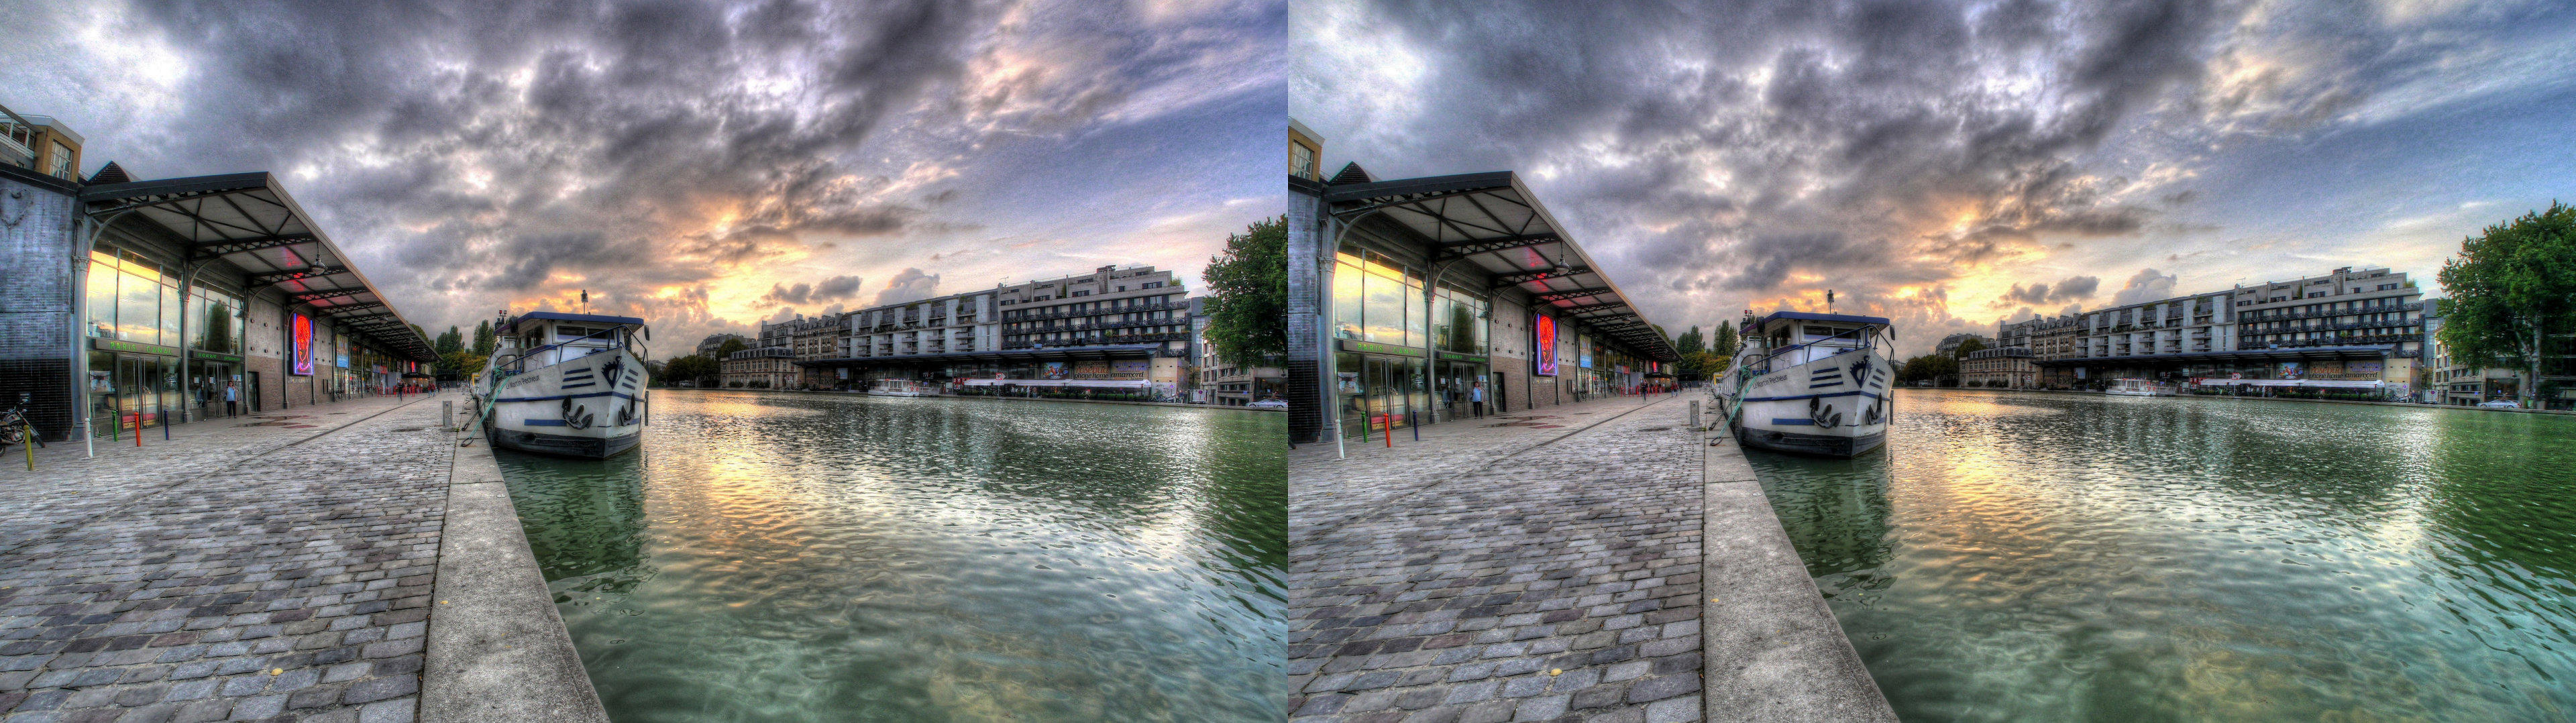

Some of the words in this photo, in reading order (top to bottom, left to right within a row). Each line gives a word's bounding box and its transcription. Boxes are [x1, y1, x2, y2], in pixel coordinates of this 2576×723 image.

[110, 341, 137, 351] PARIS
[146, 346, 172, 355] CANAL
[1357, 343, 1383, 353] PARIS
[1393, 347, 1419, 356] CANAL
